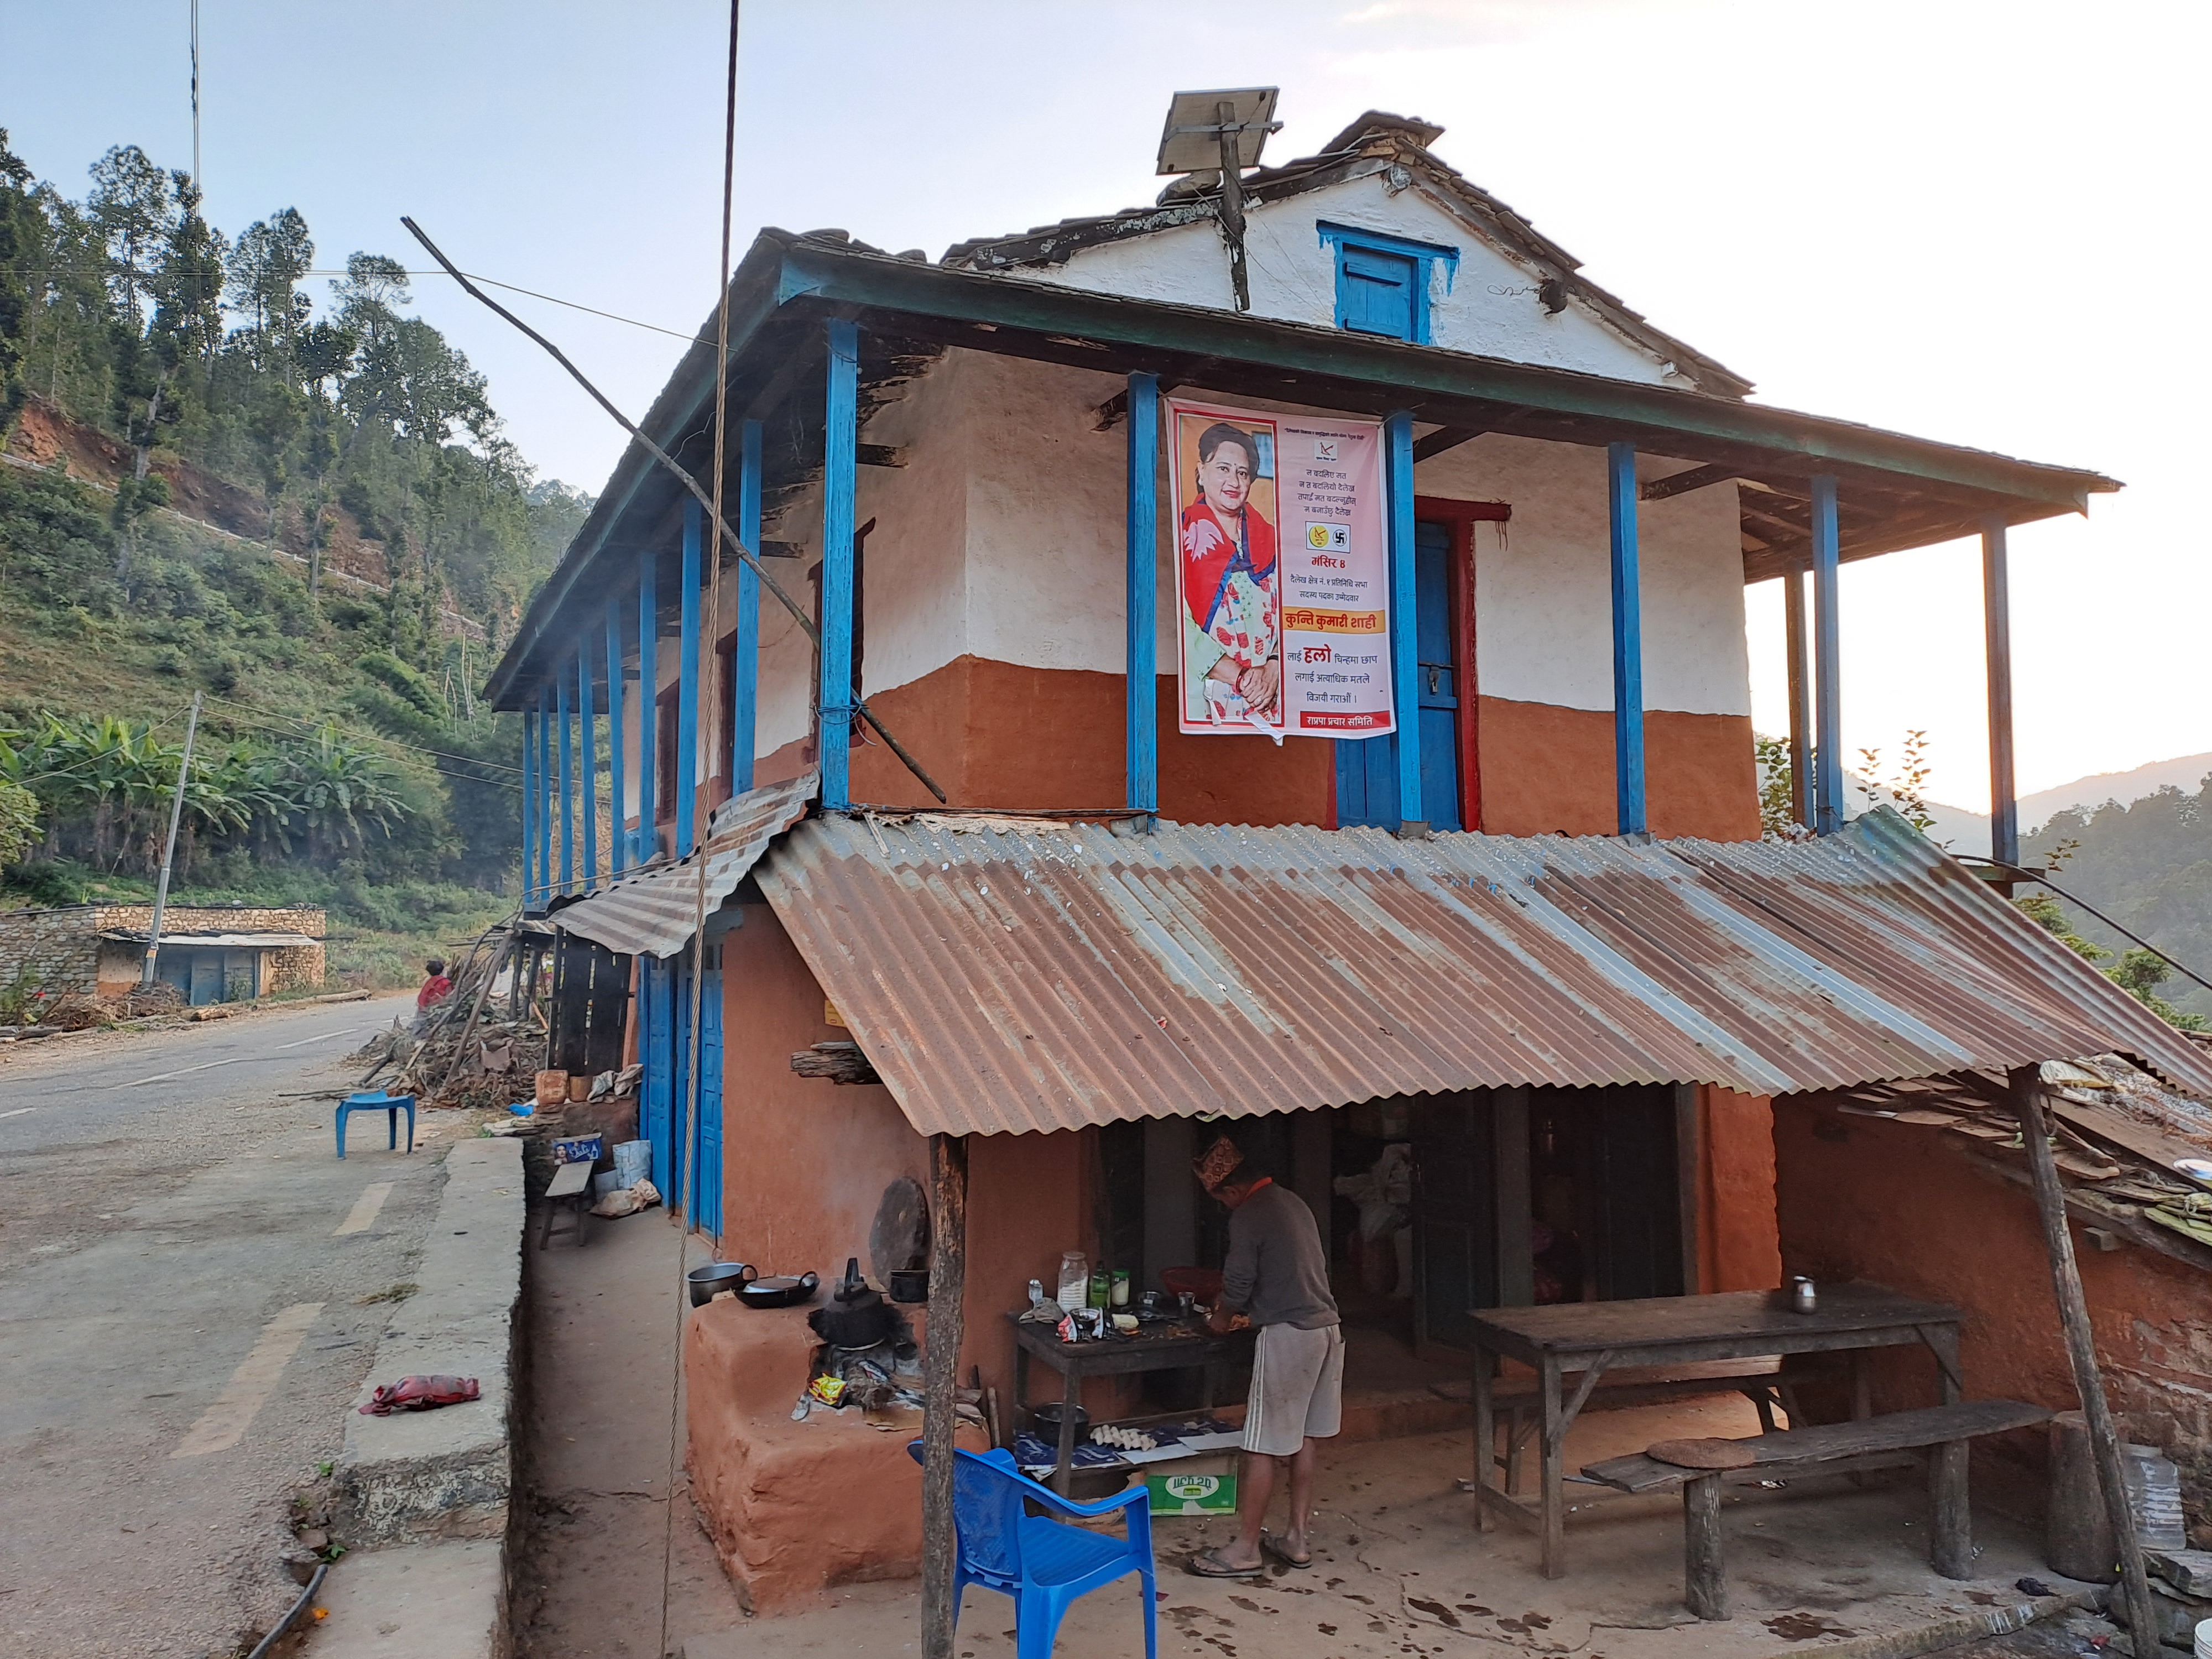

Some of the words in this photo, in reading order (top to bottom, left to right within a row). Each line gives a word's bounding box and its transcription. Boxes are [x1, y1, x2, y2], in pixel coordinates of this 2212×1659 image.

[1312, 555, 1338, 568] मंसिर
[1290, 573, 1306, 583] दैलेख
[1308, 575, 1318, 585] क्षेत्र
[1331, 577, 1353, 587] प्रतिनिधि
[1335, 592, 1359, 602] उम्मेदवार
[1285, 610, 1314, 628] कुन्ति
[1316, 613, 1348, 630] कुमारी
[1351, 614, 1376, 629] शाही
[1287, 650, 1302, 662] लाई
[1303, 644, 1332, 664] हलो
[1334, 653, 1359, 665] चिन्हमा
[1360, 655, 1378, 664] छाप
[1295, 671, 1314, 683] लगाई
[1317, 672, 1349, 684] अत्याधिक
[1350, 673, 1370, 684] मतले
[1307, 691, 1328, 702] विजयी
[1306, 717, 1327, 725] राप्रपा
[1328, 717, 1345, 726] प्रचार
[1347, 716, 1373, 726] समिति
